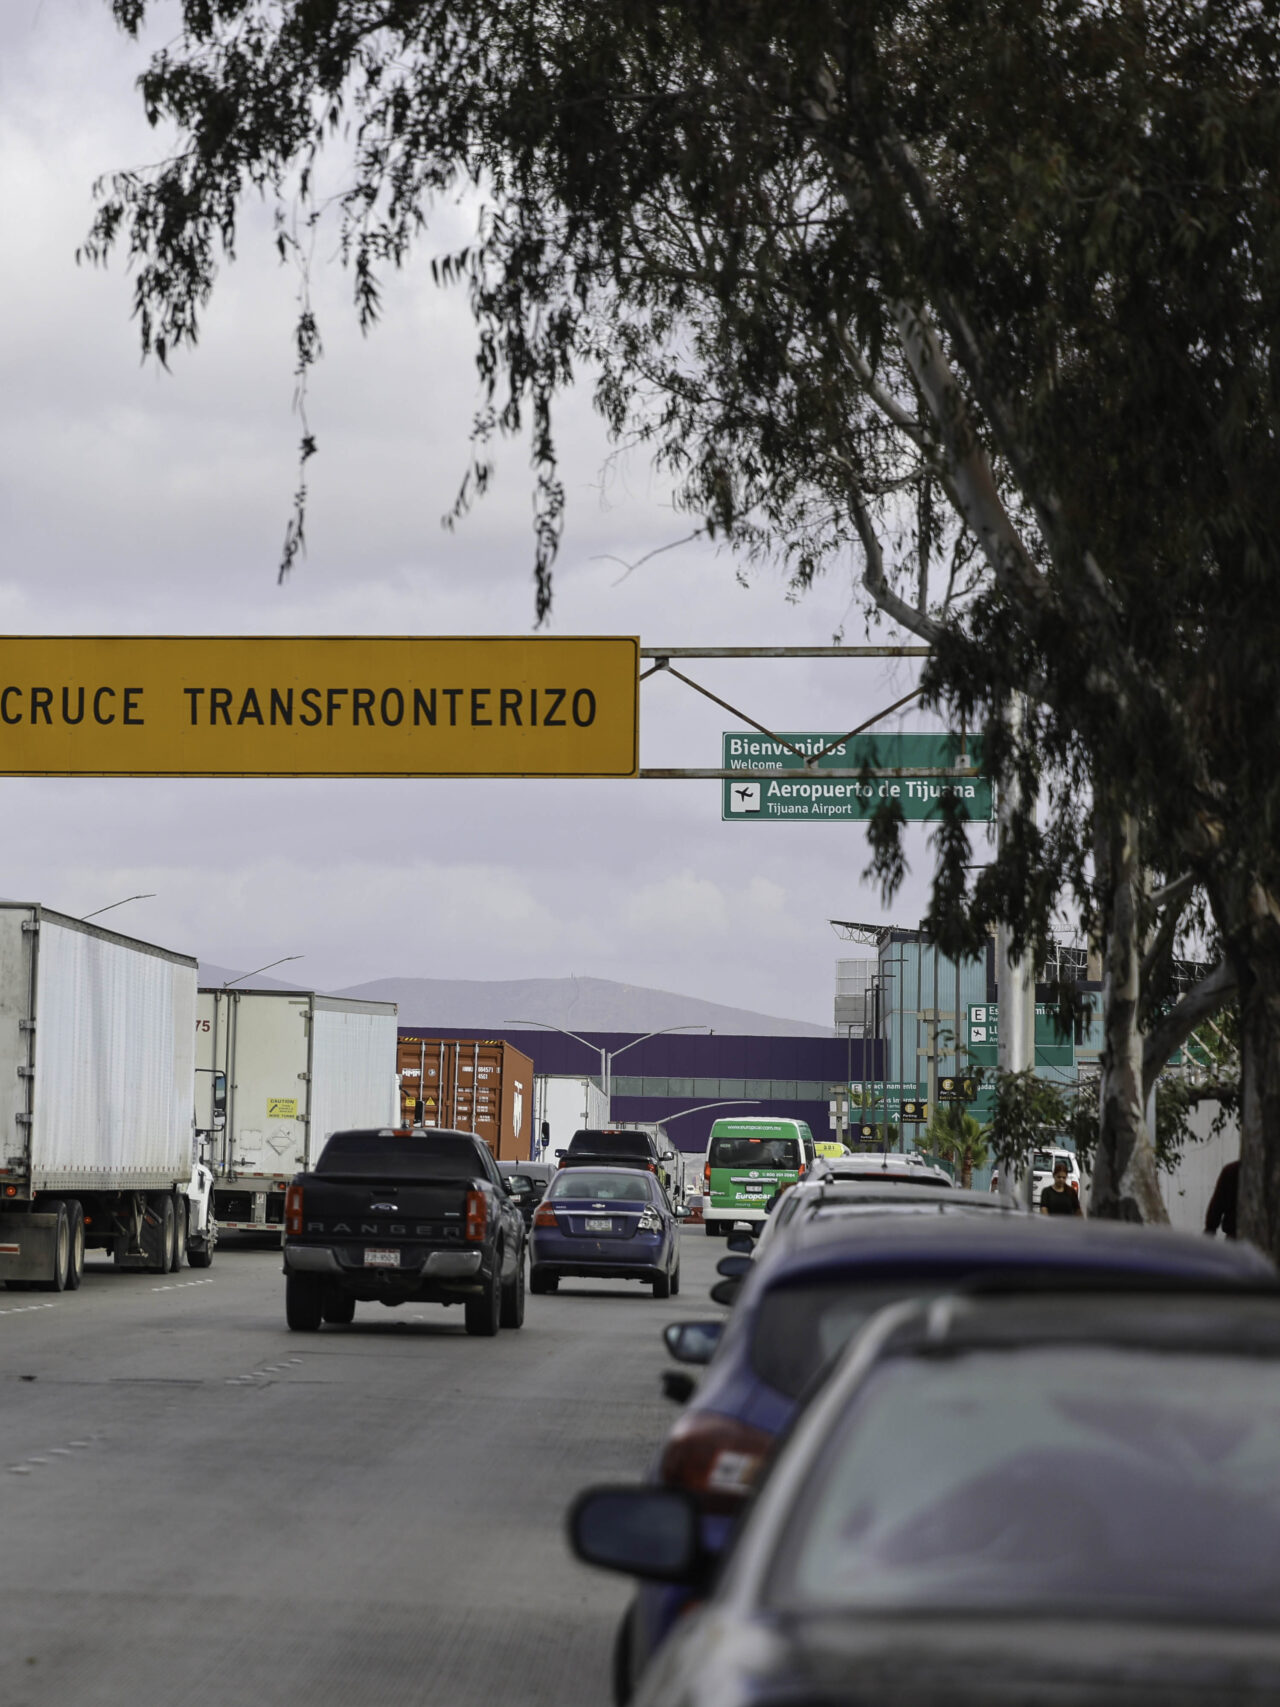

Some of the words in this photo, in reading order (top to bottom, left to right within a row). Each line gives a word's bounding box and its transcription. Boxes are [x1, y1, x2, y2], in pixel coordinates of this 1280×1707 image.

[0, 686, 145, 727] CRUCE
[184, 687, 598, 728] TRANSFRONTERIZO
[730, 738, 847, 755] Bienvenidos
[730, 759, 783, 769] Welcome
[767, 781, 873, 801] Aeropuerto
[878, 780, 901, 798] de
[767, 803, 809, 815] Tijuana
[811, 803, 852, 815] Airport
[735, 1192, 771, 1201] Europcar
[307, 1222, 460, 1236] RANGER
